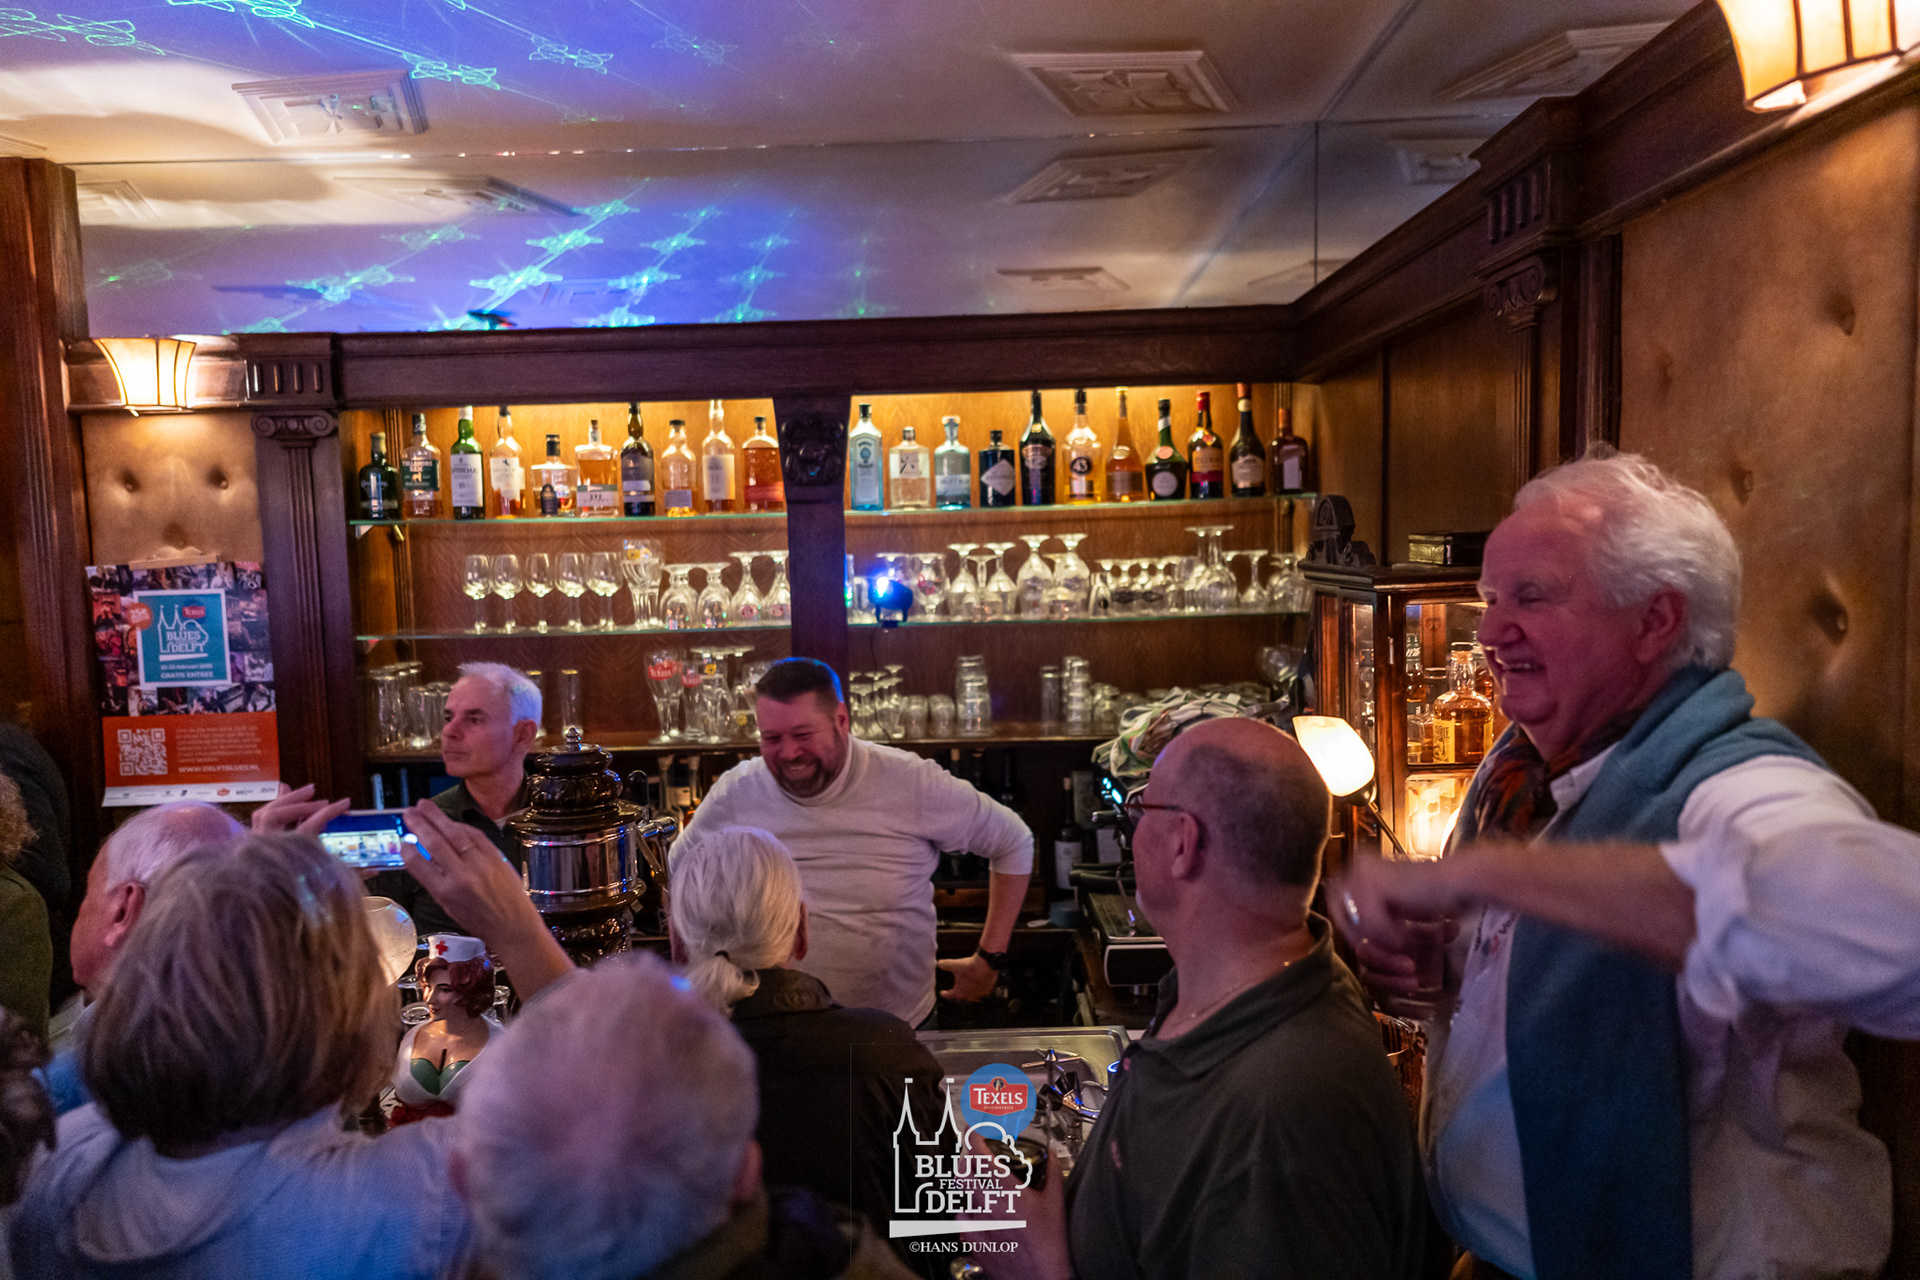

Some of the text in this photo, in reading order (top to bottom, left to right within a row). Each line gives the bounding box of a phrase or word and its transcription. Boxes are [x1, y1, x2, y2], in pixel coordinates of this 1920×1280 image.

[166, 631, 201, 641] BLUES
[171, 642, 205, 653] DELFT
[160, 671, 186, 679] GRATIS
